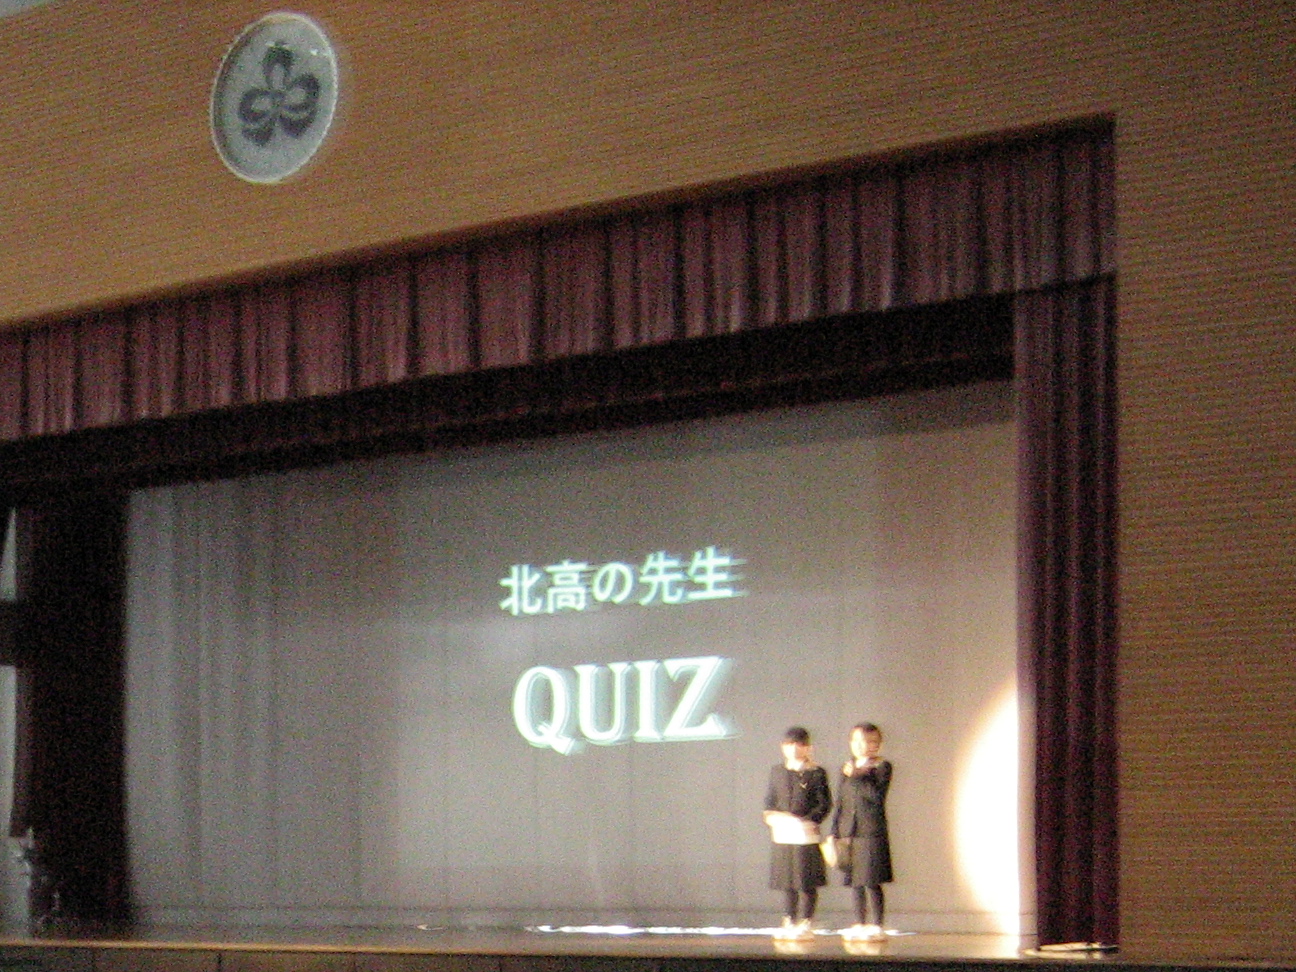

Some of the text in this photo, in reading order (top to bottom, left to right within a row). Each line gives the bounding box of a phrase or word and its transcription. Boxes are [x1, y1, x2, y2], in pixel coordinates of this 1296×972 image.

[499, 545, 740, 616] 北高の先生
[513, 655, 730, 756] QUIZ
